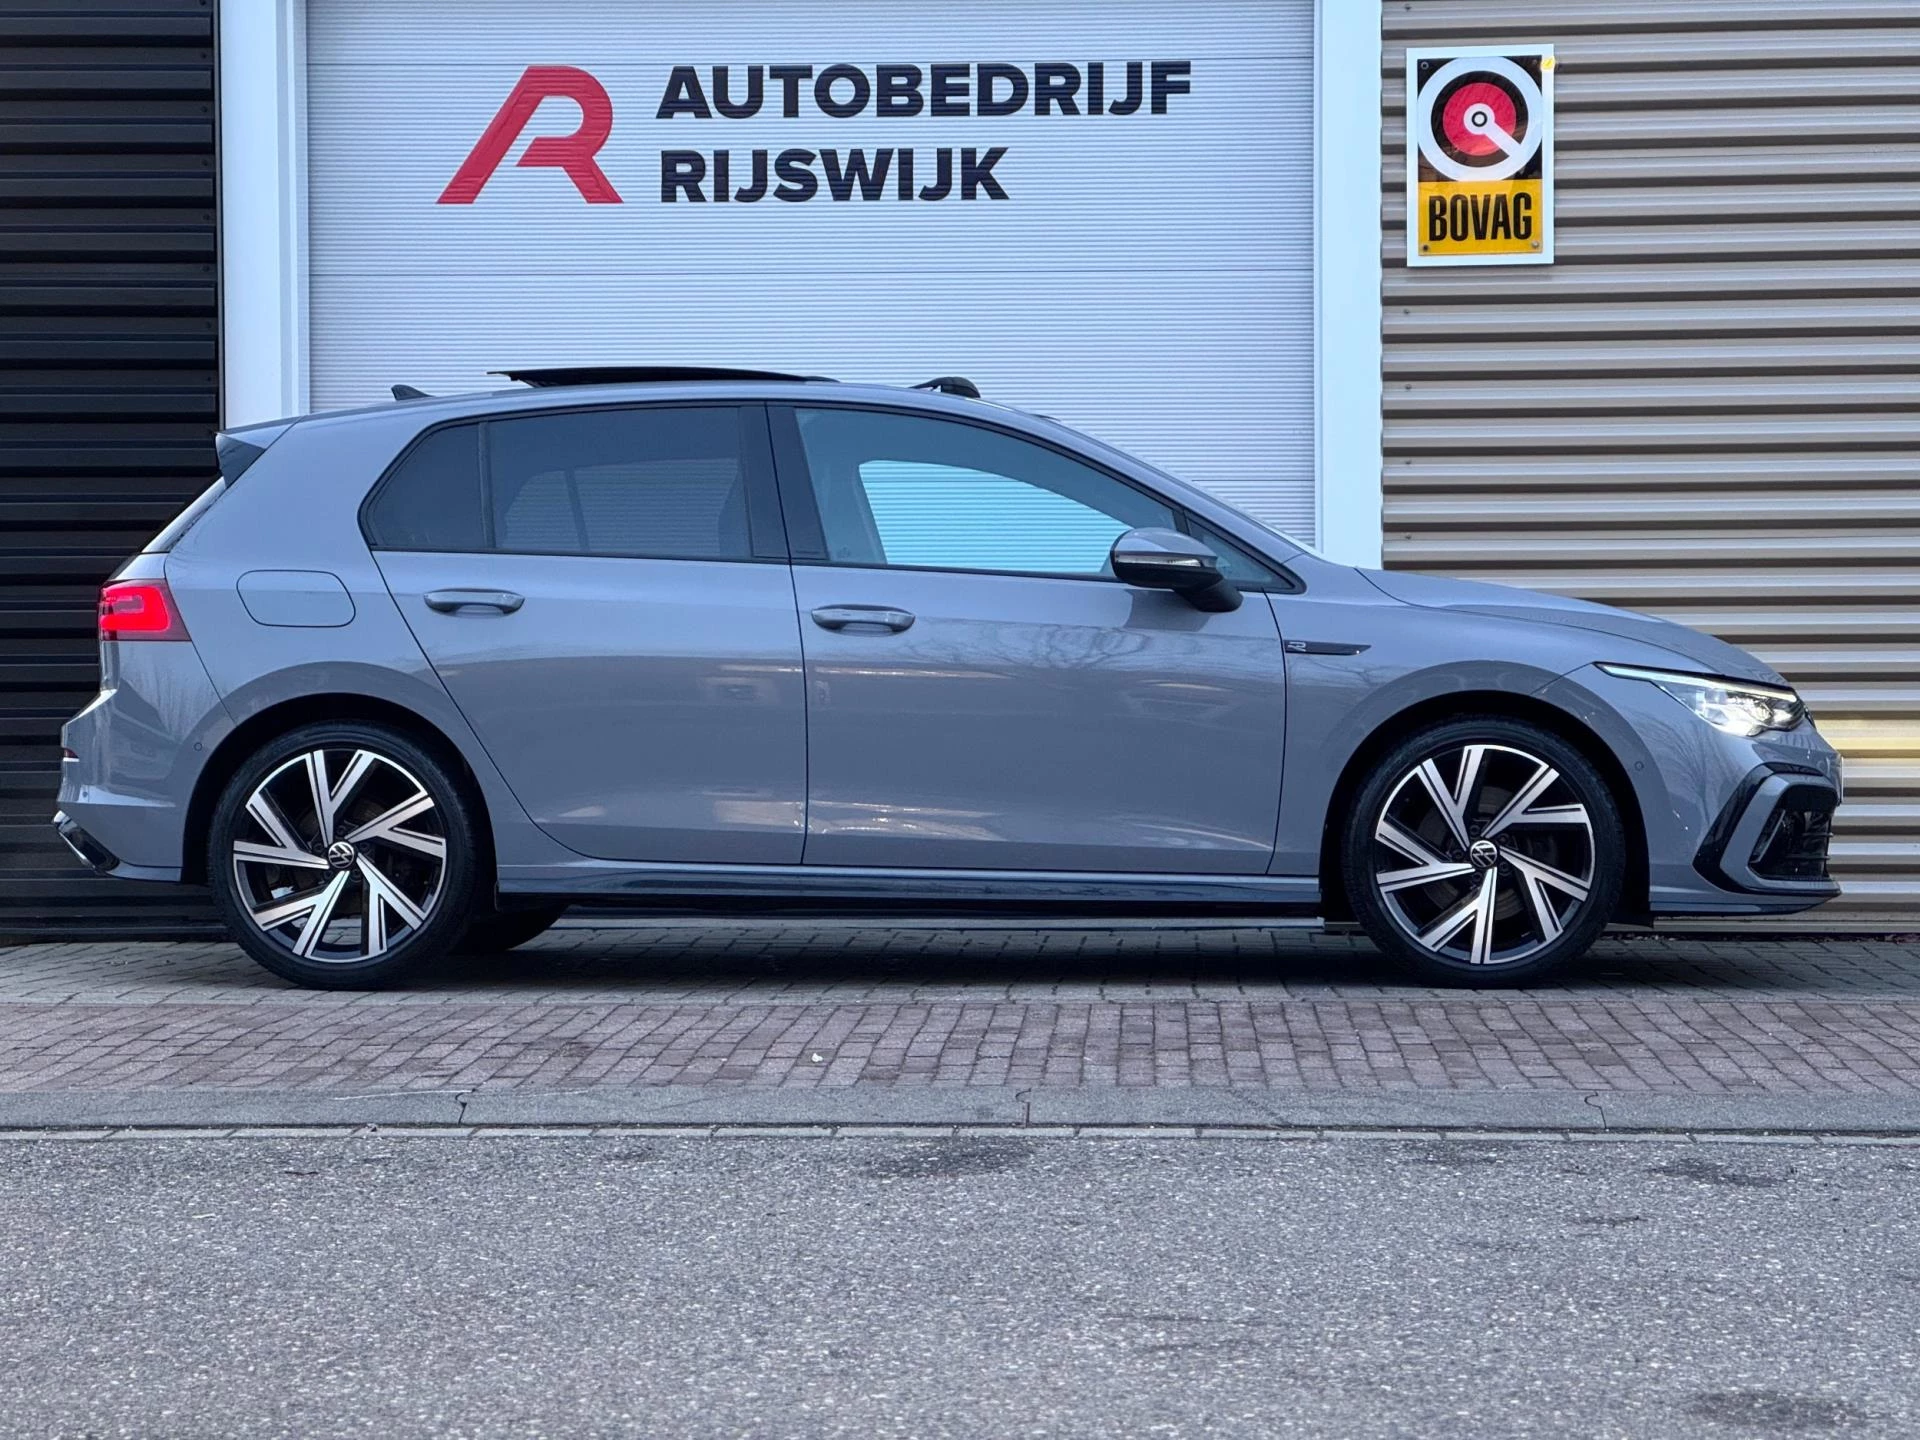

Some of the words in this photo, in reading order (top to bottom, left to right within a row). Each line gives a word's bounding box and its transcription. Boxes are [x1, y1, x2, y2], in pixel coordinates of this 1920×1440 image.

[656, 61, 1191, 119] AUTOBEDRIJF
[662, 147, 1010, 203] RIJSWIJK
[1428, 192, 1532, 242] BOVAG
